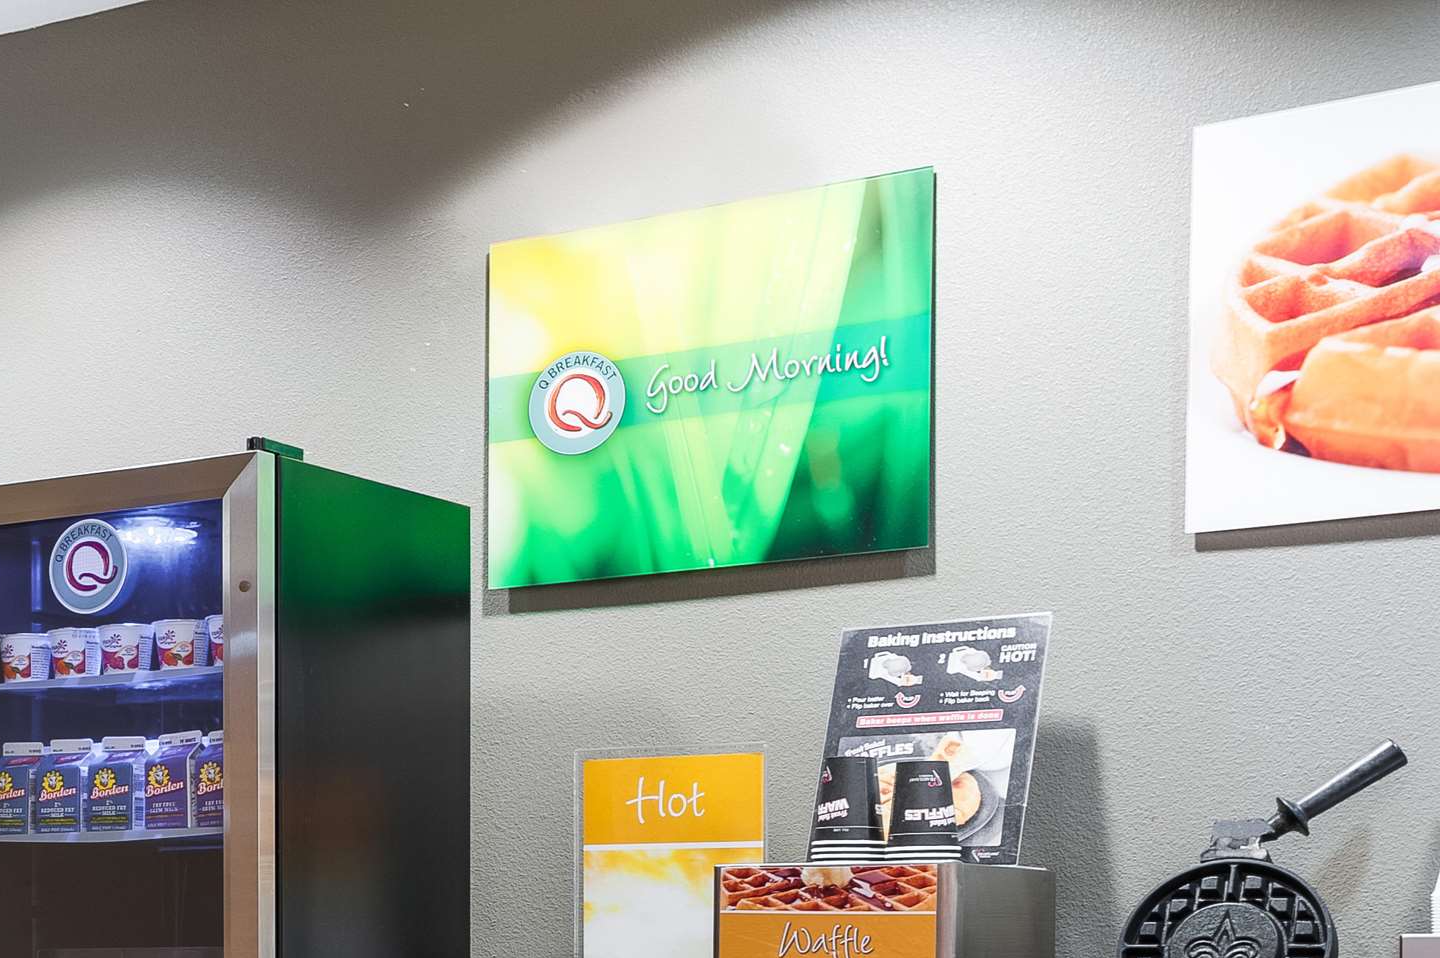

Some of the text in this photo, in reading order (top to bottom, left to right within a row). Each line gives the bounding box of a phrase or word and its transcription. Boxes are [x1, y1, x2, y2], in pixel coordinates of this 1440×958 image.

[538, 355, 617, 390] Q BREAKFAST
[646, 335, 890, 414] Good Morning!
[547, 373, 613, 432] Q
[55, 524, 114, 563] Q BREAKFAST
[65, 540, 118, 592] Q
[867, 626, 1016, 648] Baking Instructions
[1000, 643, 1037, 652] CAUTION
[863, 658, 869, 669] 1
[937, 653, 947, 664] 2
[999, 651, 1037, 664] HOT!
[854, 742, 914, 758] AFFLES
[39, 787, 77, 802] Borden
[90, 784, 129, 800] Borden
[145, 780, 184, 798] Borden
[197, 779, 224, 795] Bord
[625, 776, 705, 825] Hot
